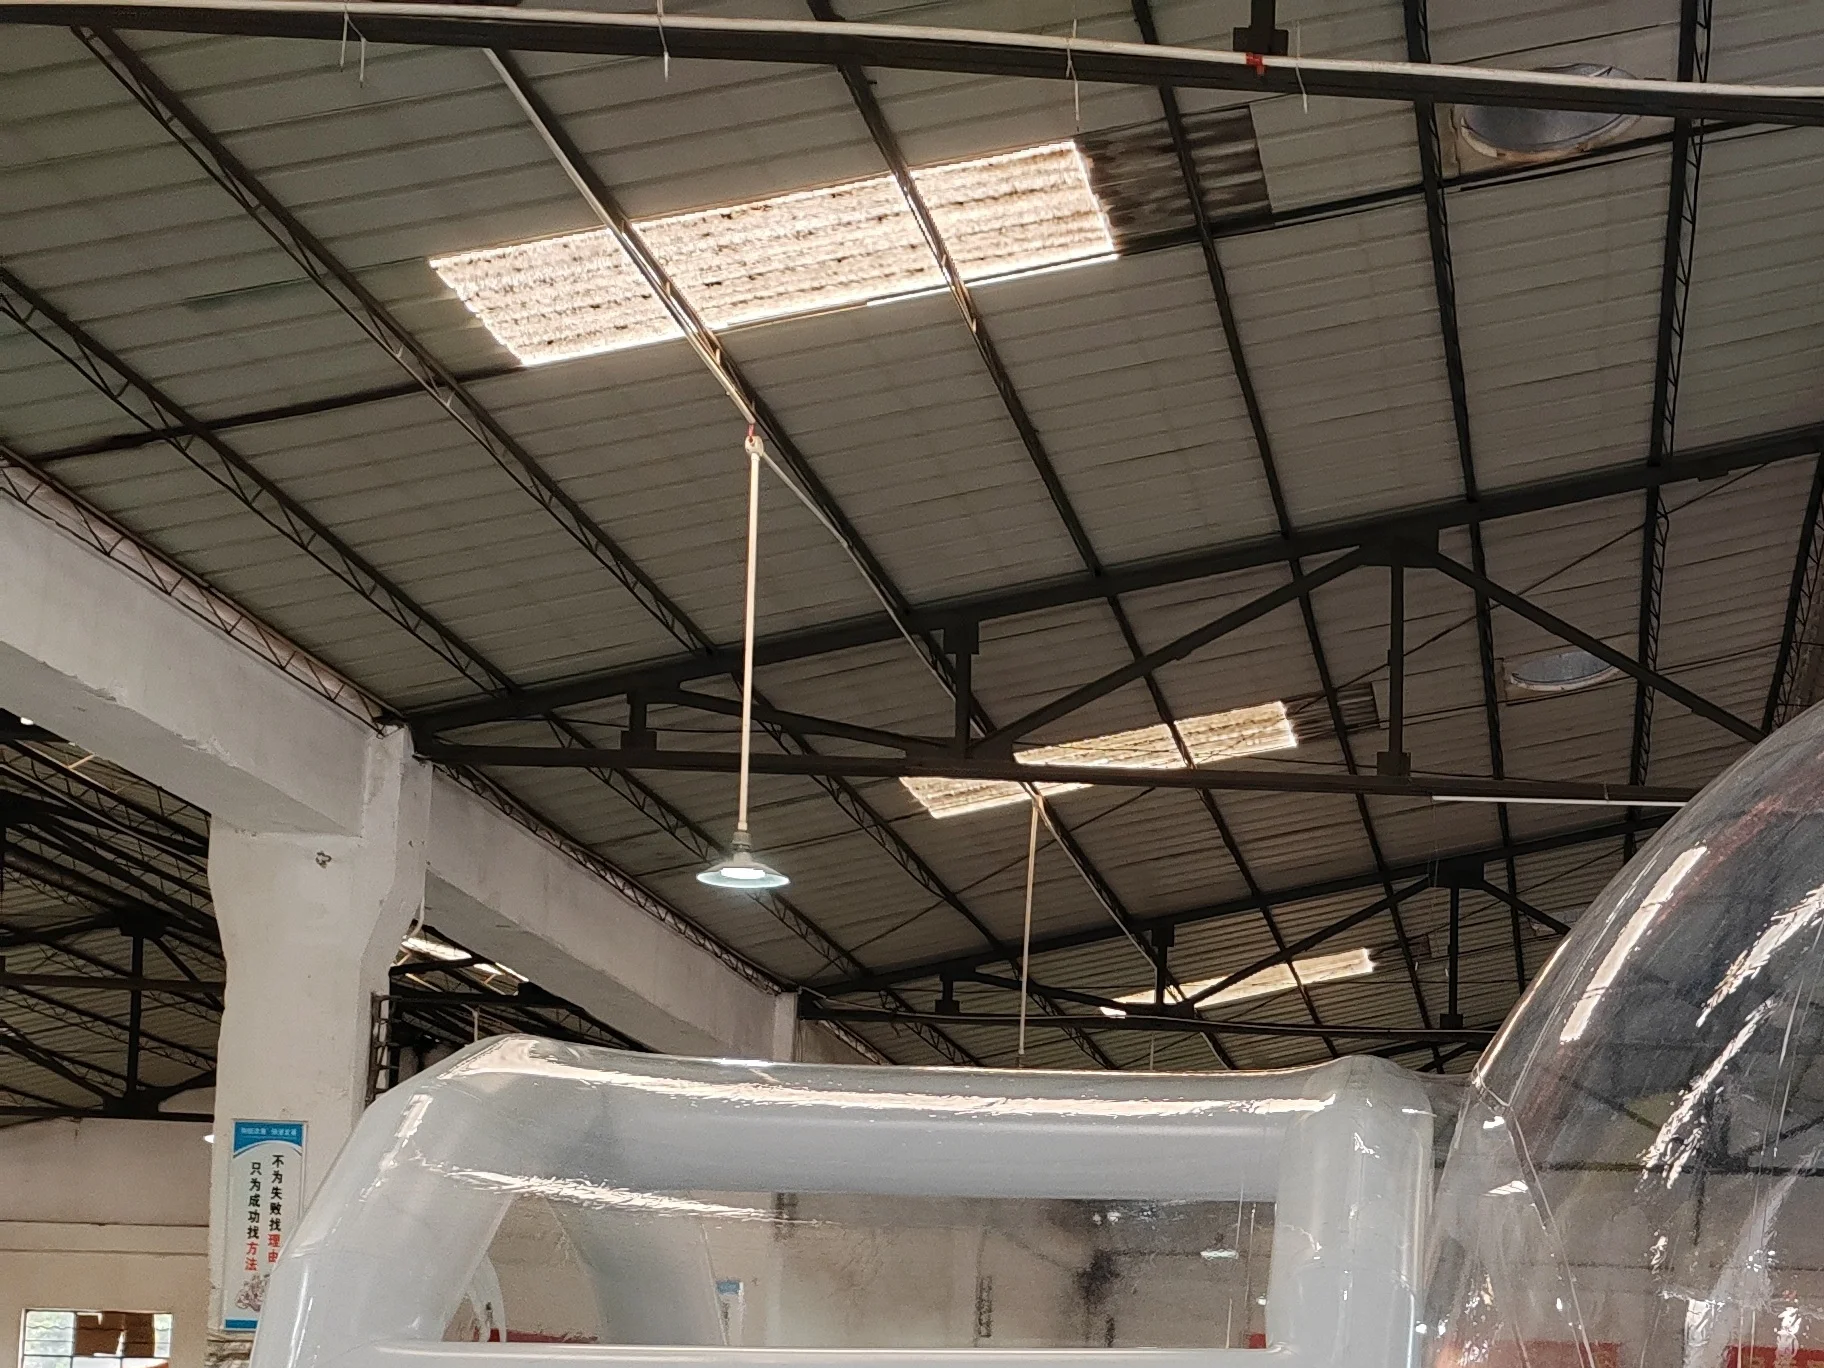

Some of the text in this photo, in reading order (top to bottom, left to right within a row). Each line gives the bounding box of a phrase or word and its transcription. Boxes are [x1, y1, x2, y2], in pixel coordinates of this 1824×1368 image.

[245, 1162, 262, 1271] 只为成功找方法
[267, 1154, 284, 1263] 不为失败找理由
